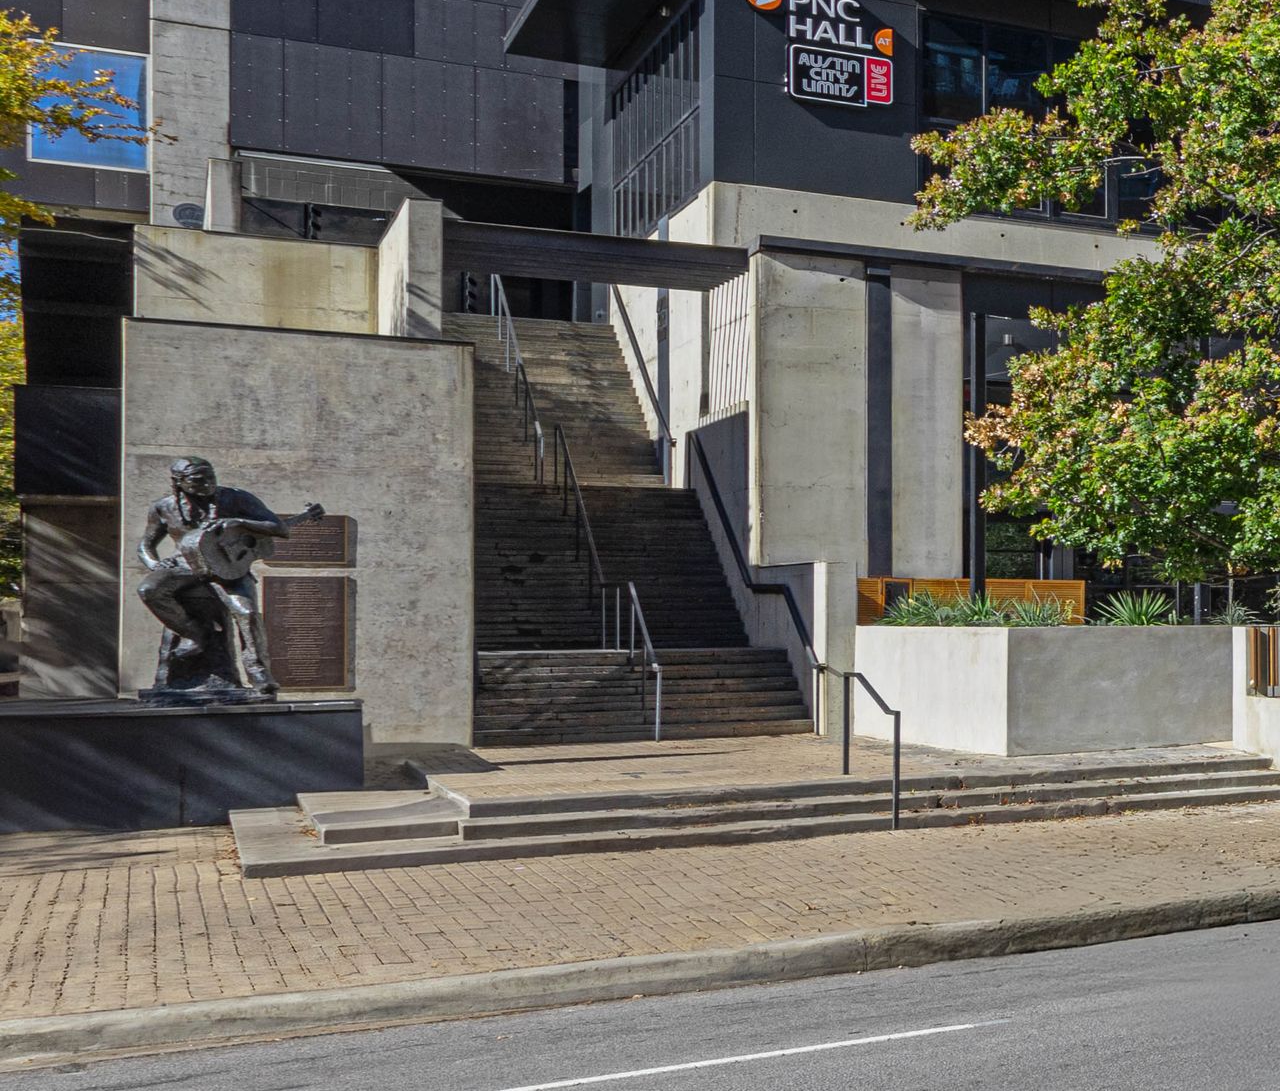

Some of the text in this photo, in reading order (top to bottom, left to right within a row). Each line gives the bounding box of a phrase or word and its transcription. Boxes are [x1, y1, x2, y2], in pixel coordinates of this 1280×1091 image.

[789, 14, 873, 50] HALL
[877, 37, 891, 46] AT
[798, 52, 861, 75] AUSTIN
[809, 67, 849, 84] CITY
[802, 78, 858, 98] LIMITS
